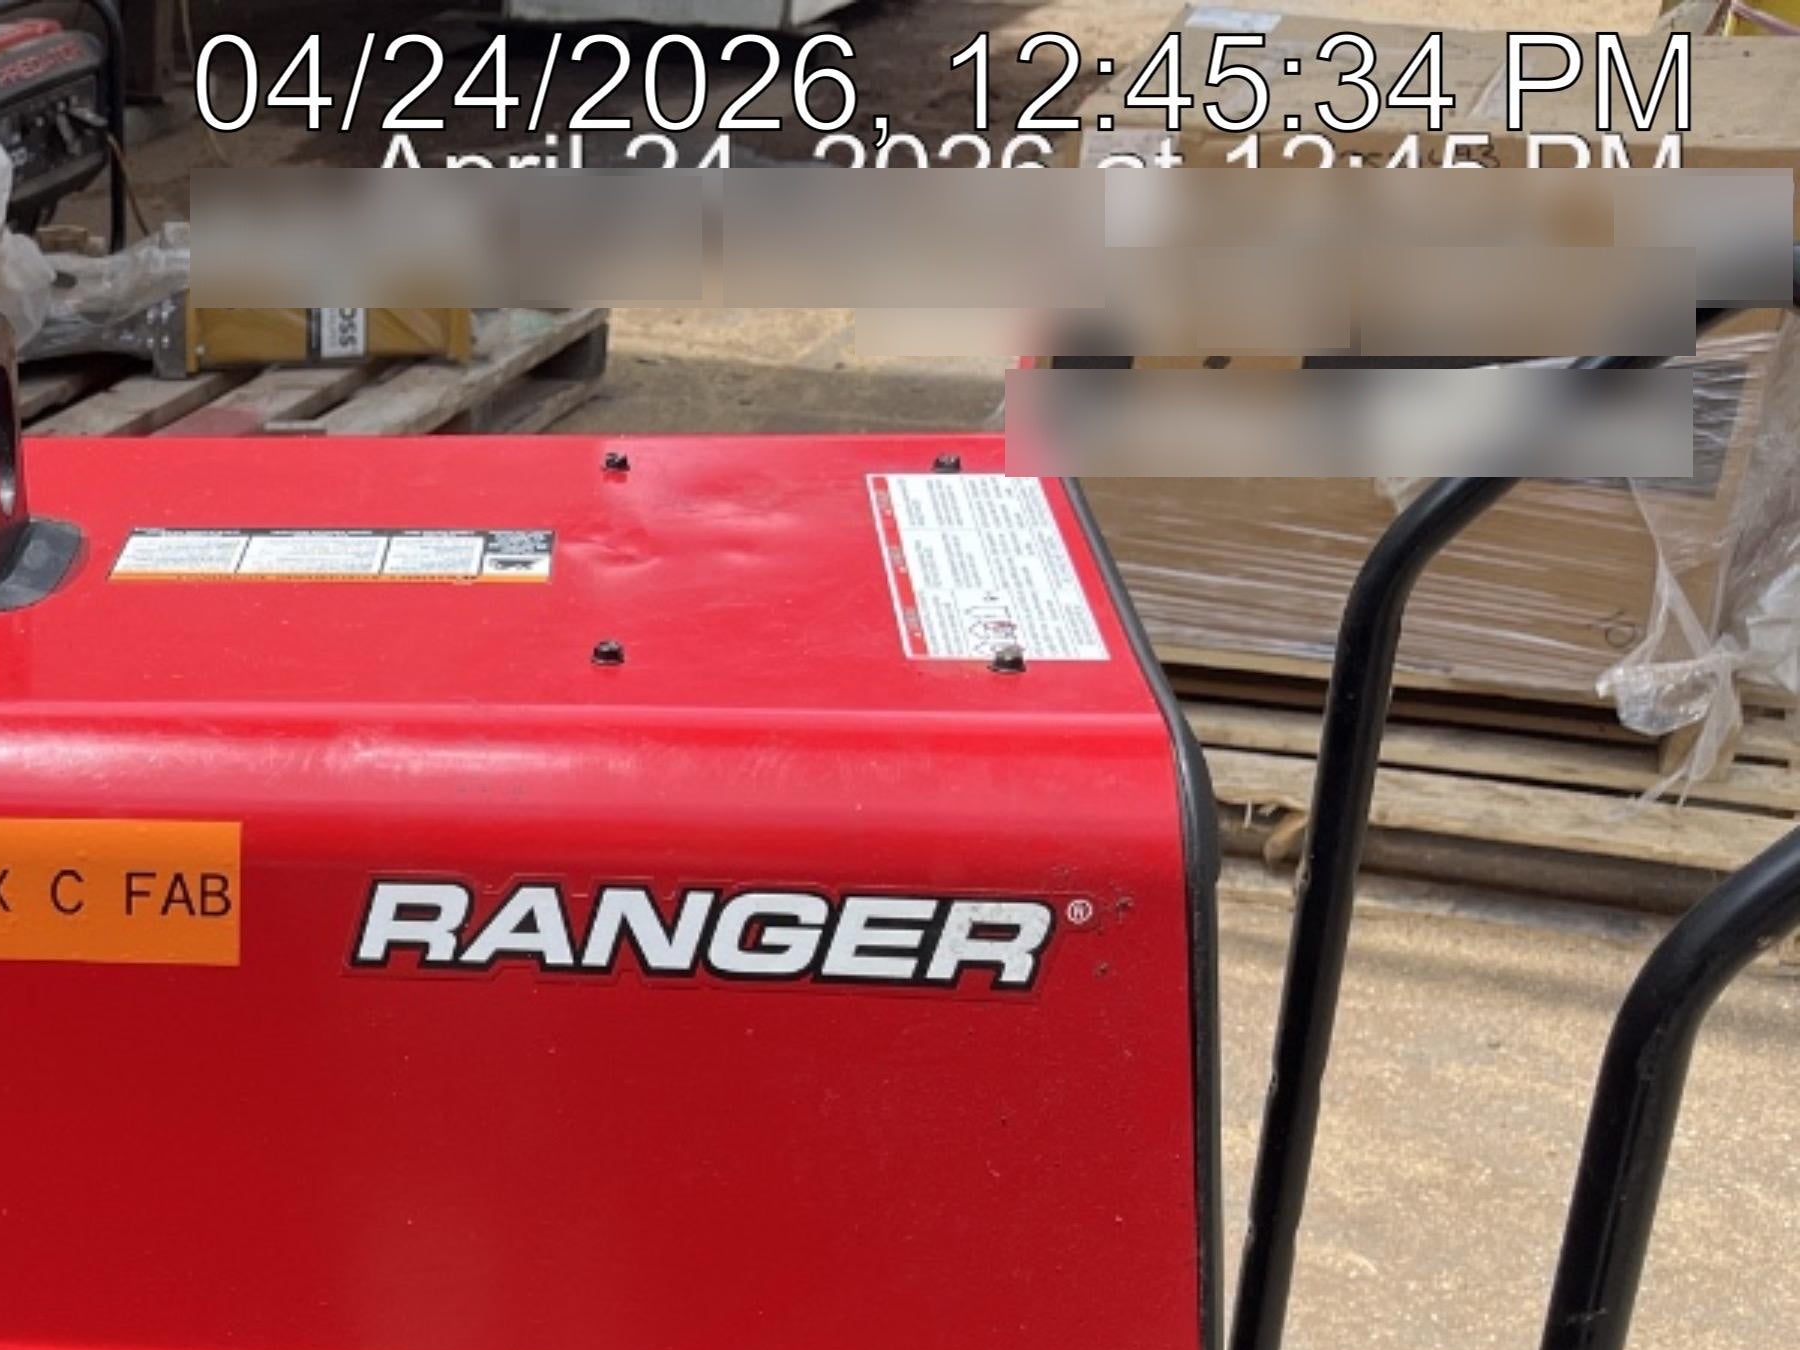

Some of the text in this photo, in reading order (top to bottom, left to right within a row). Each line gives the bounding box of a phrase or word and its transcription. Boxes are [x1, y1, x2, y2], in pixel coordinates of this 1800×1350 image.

[49, 868, 85, 916] C
[124, 871, 233, 917] FAB
[351, 881, 1053, 986] RANGER
